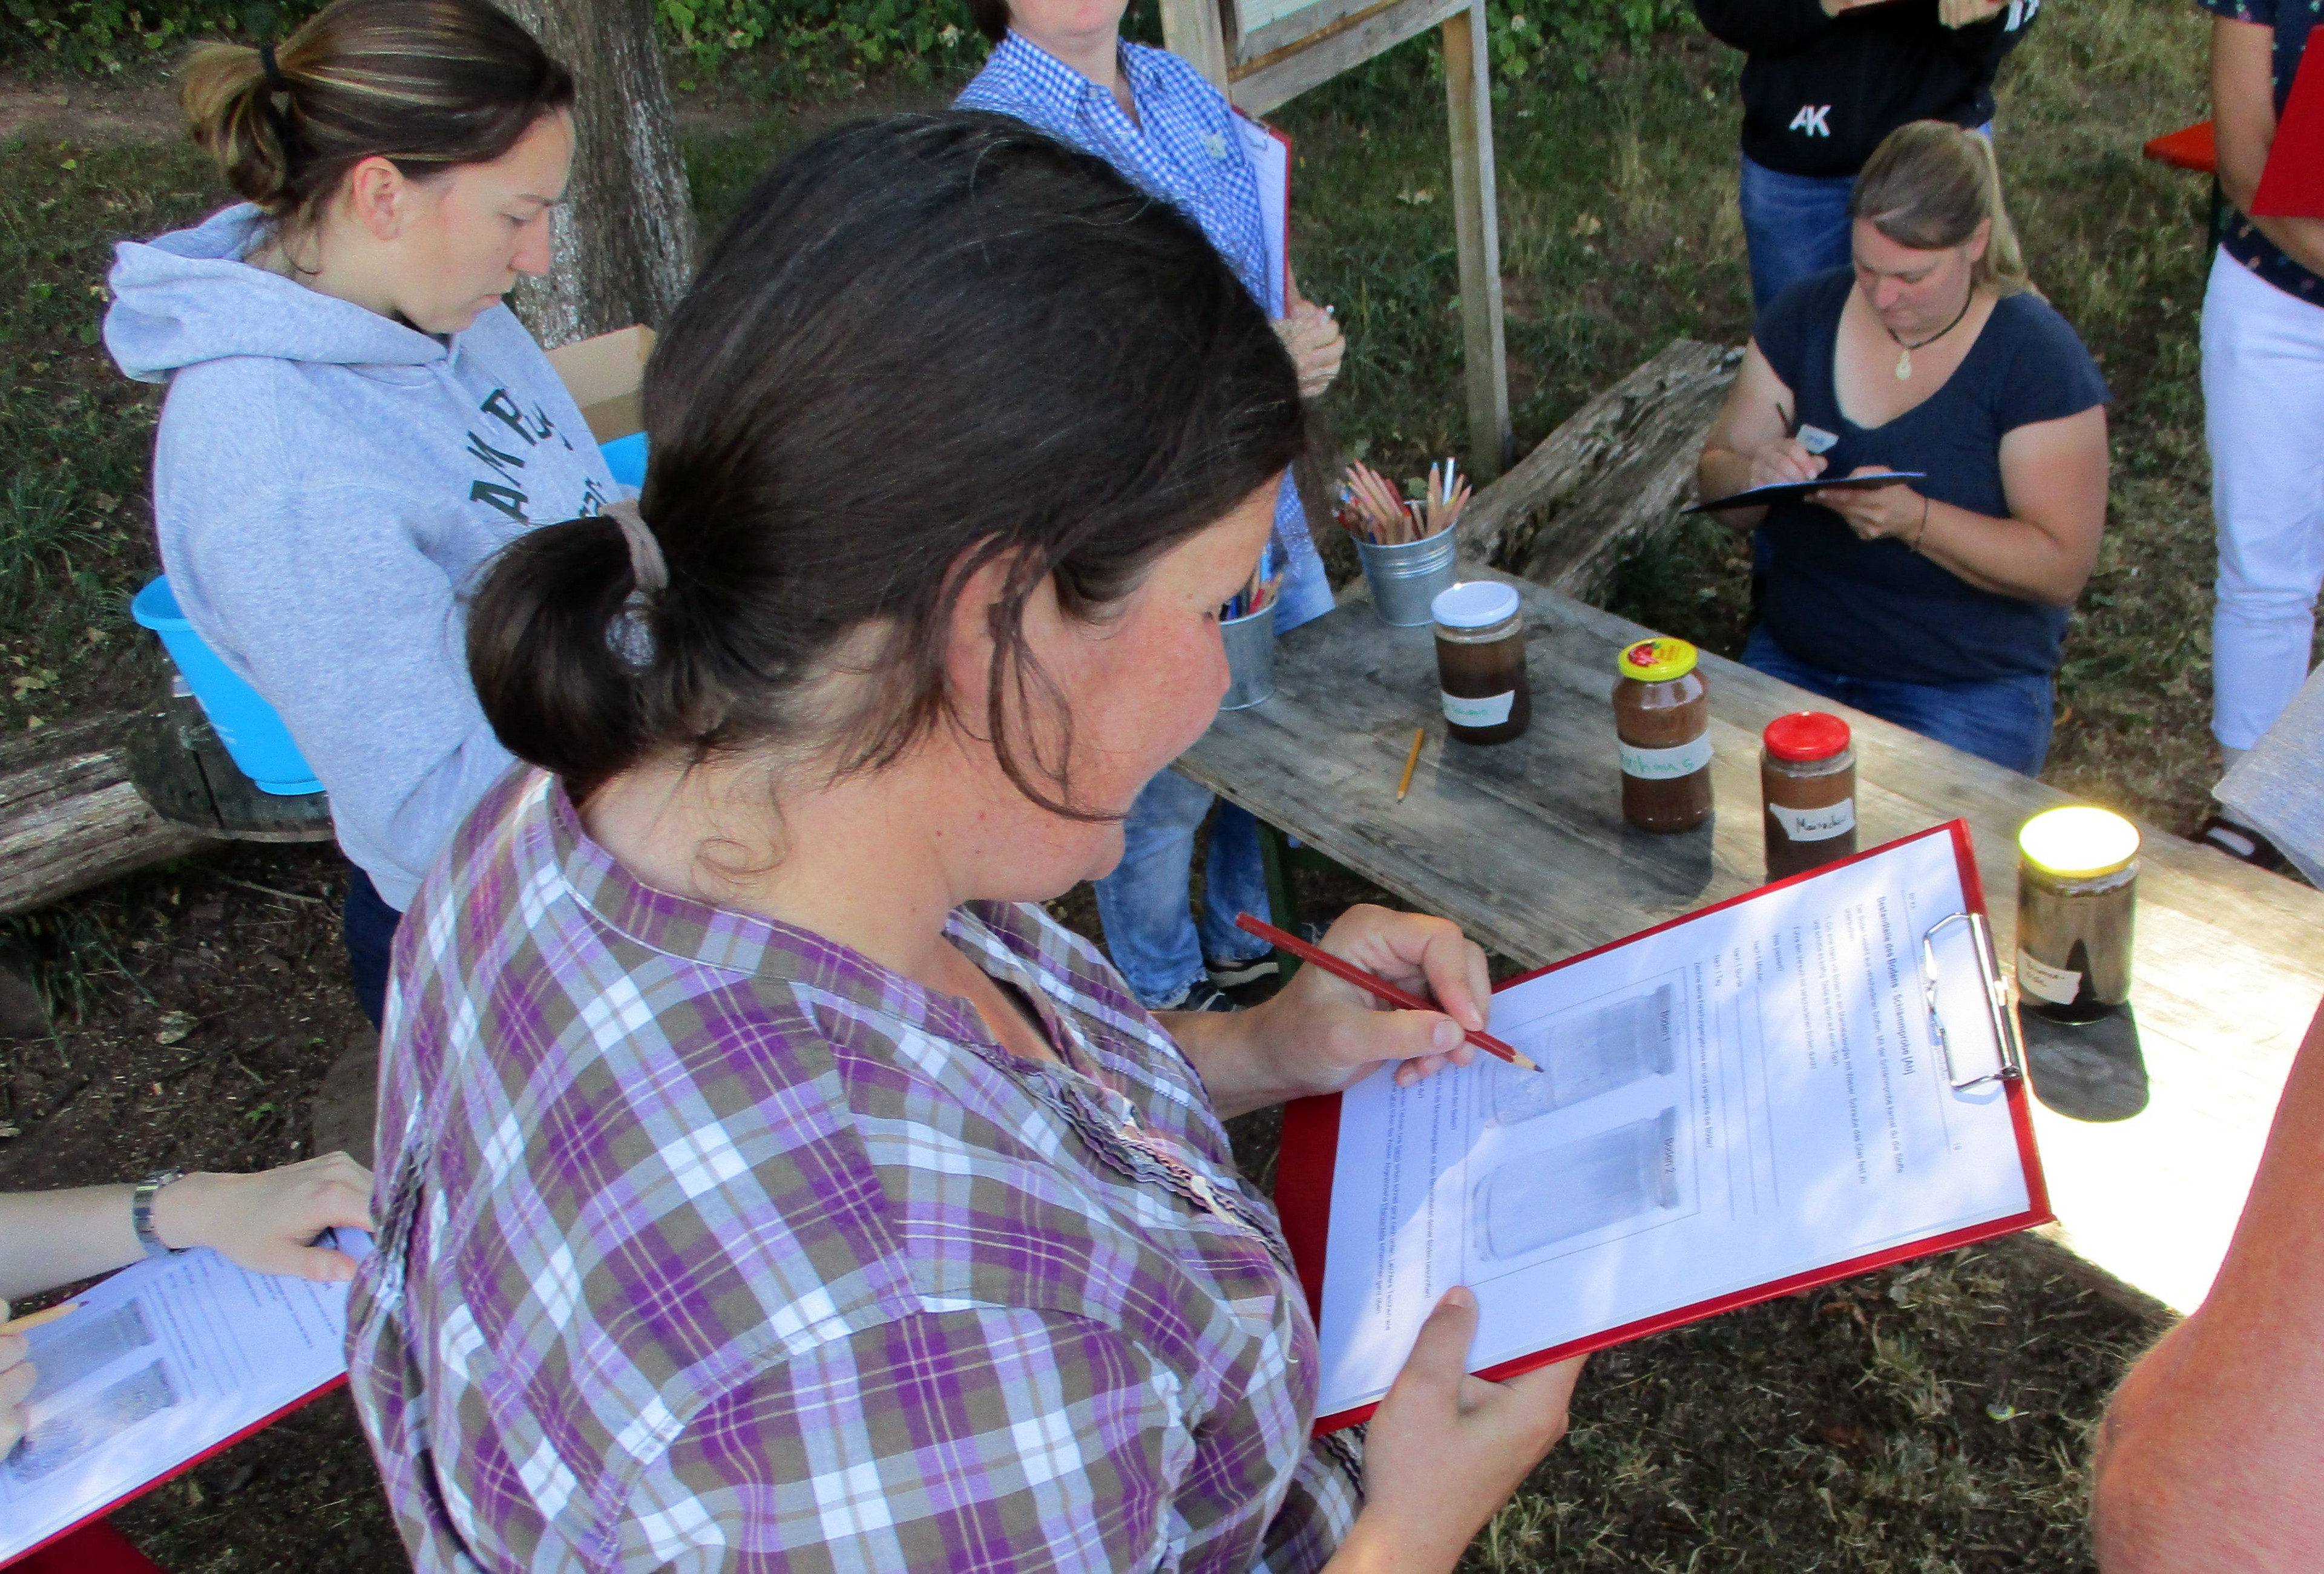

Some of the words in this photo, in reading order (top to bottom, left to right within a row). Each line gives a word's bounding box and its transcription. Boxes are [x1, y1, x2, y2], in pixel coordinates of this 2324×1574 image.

[1788, 104, 1831, 137] AK
[1876, 895, 1894, 943] Bestandteile
[1883, 942, 1896, 959] des
[1885, 957, 1901, 989] Bodens
[1662, 1136, 1676, 1168] Boden
[1664, 1165, 1677, 1175] 2
